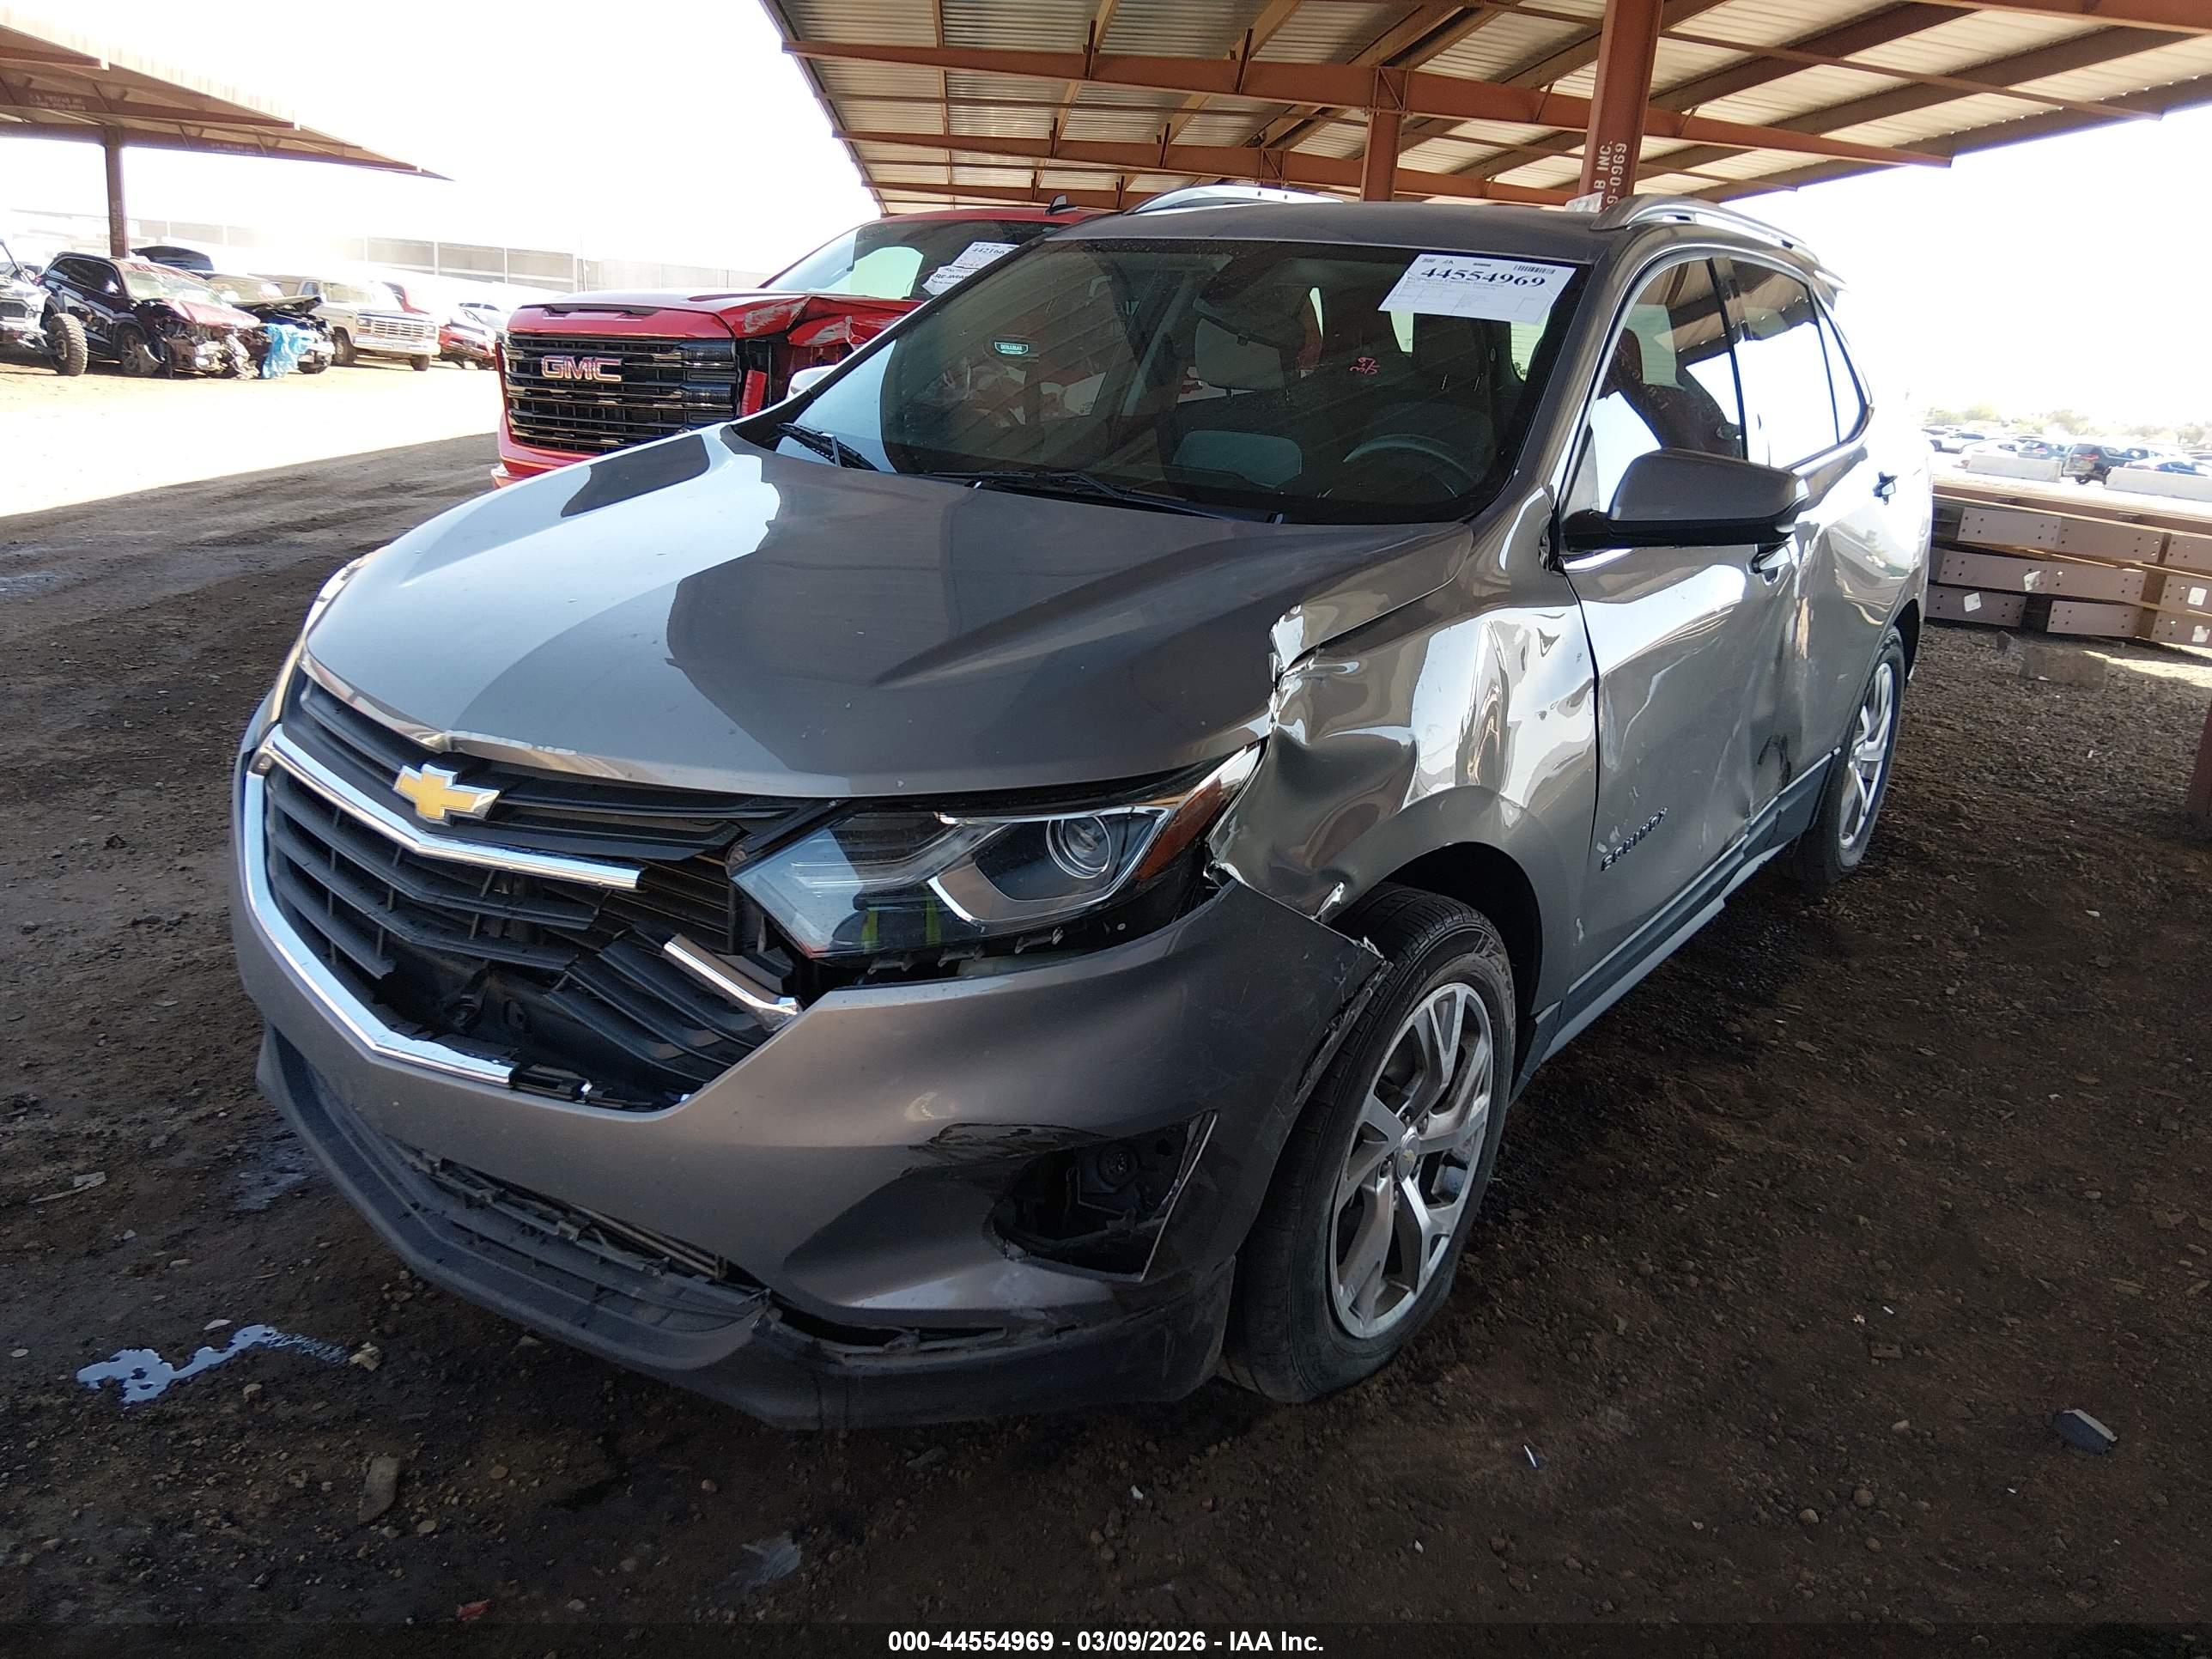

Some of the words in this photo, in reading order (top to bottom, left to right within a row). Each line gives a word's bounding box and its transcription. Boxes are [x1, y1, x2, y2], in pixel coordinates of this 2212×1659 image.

[1596, 141, 1613, 171] INC.
[1606, 143, 1627, 207] 9-0969
[1420, 267, 1546, 288] 44554969
[541, 355, 622, 381] GMC
[1601, 806, 1668, 872] EQUINOX
